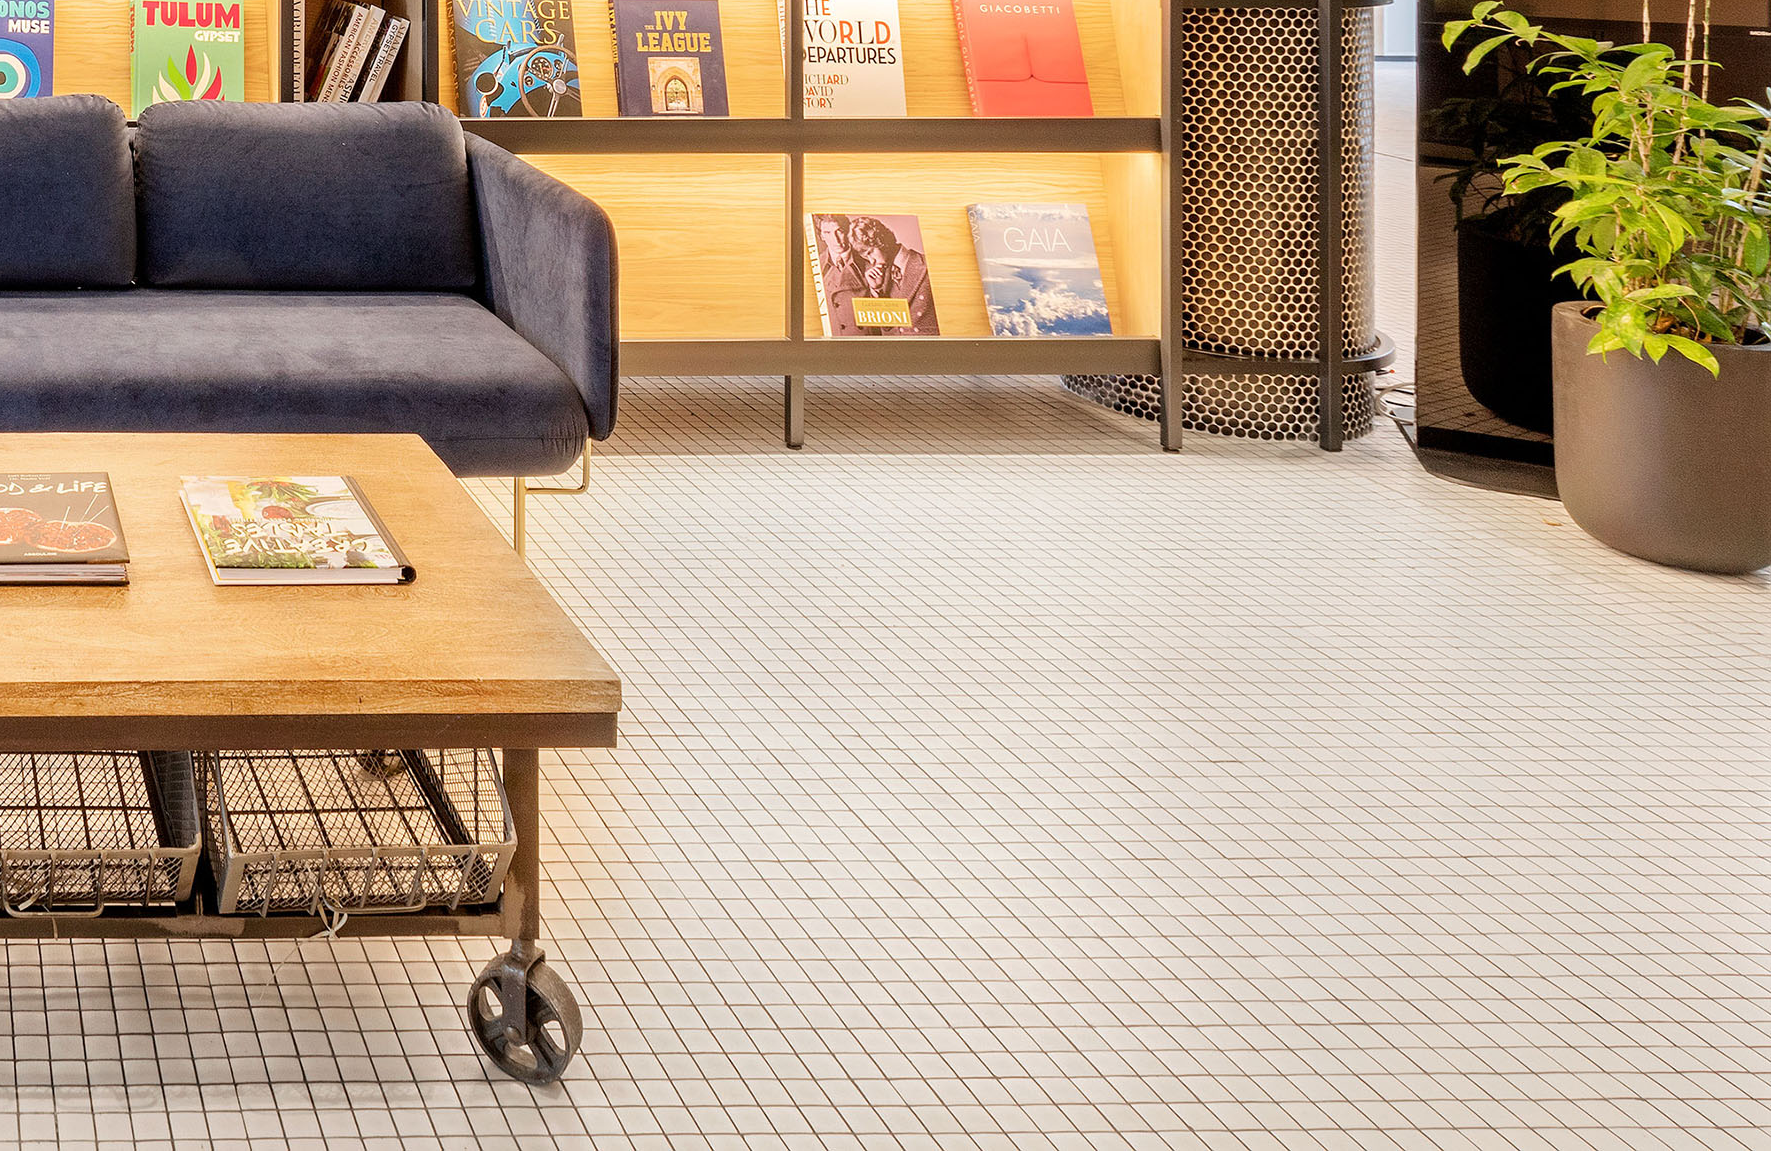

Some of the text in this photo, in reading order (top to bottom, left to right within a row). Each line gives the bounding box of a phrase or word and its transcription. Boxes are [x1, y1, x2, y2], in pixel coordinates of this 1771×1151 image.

[142, 0, 242, 30] TULUM
[655, 10, 688, 31] IVY
[979, 3, 1062, 15] GIACOBETTI
[7, 19, 50, 34] MUSE
[194, 29, 241, 43] GYPSET
[474, 19, 558, 46] CARS
[369, 24, 399, 83] GYPSET TRAVEL
[383, 25, 407, 66] SHAKER
[636, 32, 712, 53] LEAGUE
[803, 46, 897, 65] EPARTURES
[322, 12, 364, 103] AMERICAN FASHION MENS
[337, 42, 363, 91] ACCESSORIES
[340, 73, 358, 103] FASHI
[804, 74, 849, 85] ICHARD
[962, 46, 979, 114] GIACOBETT
[968, 210, 980, 243] GAIA
[1003, 227, 1072, 253] GAIA
[857, 311, 908, 324] BRIONI
[29, 482, 53, 494] &
